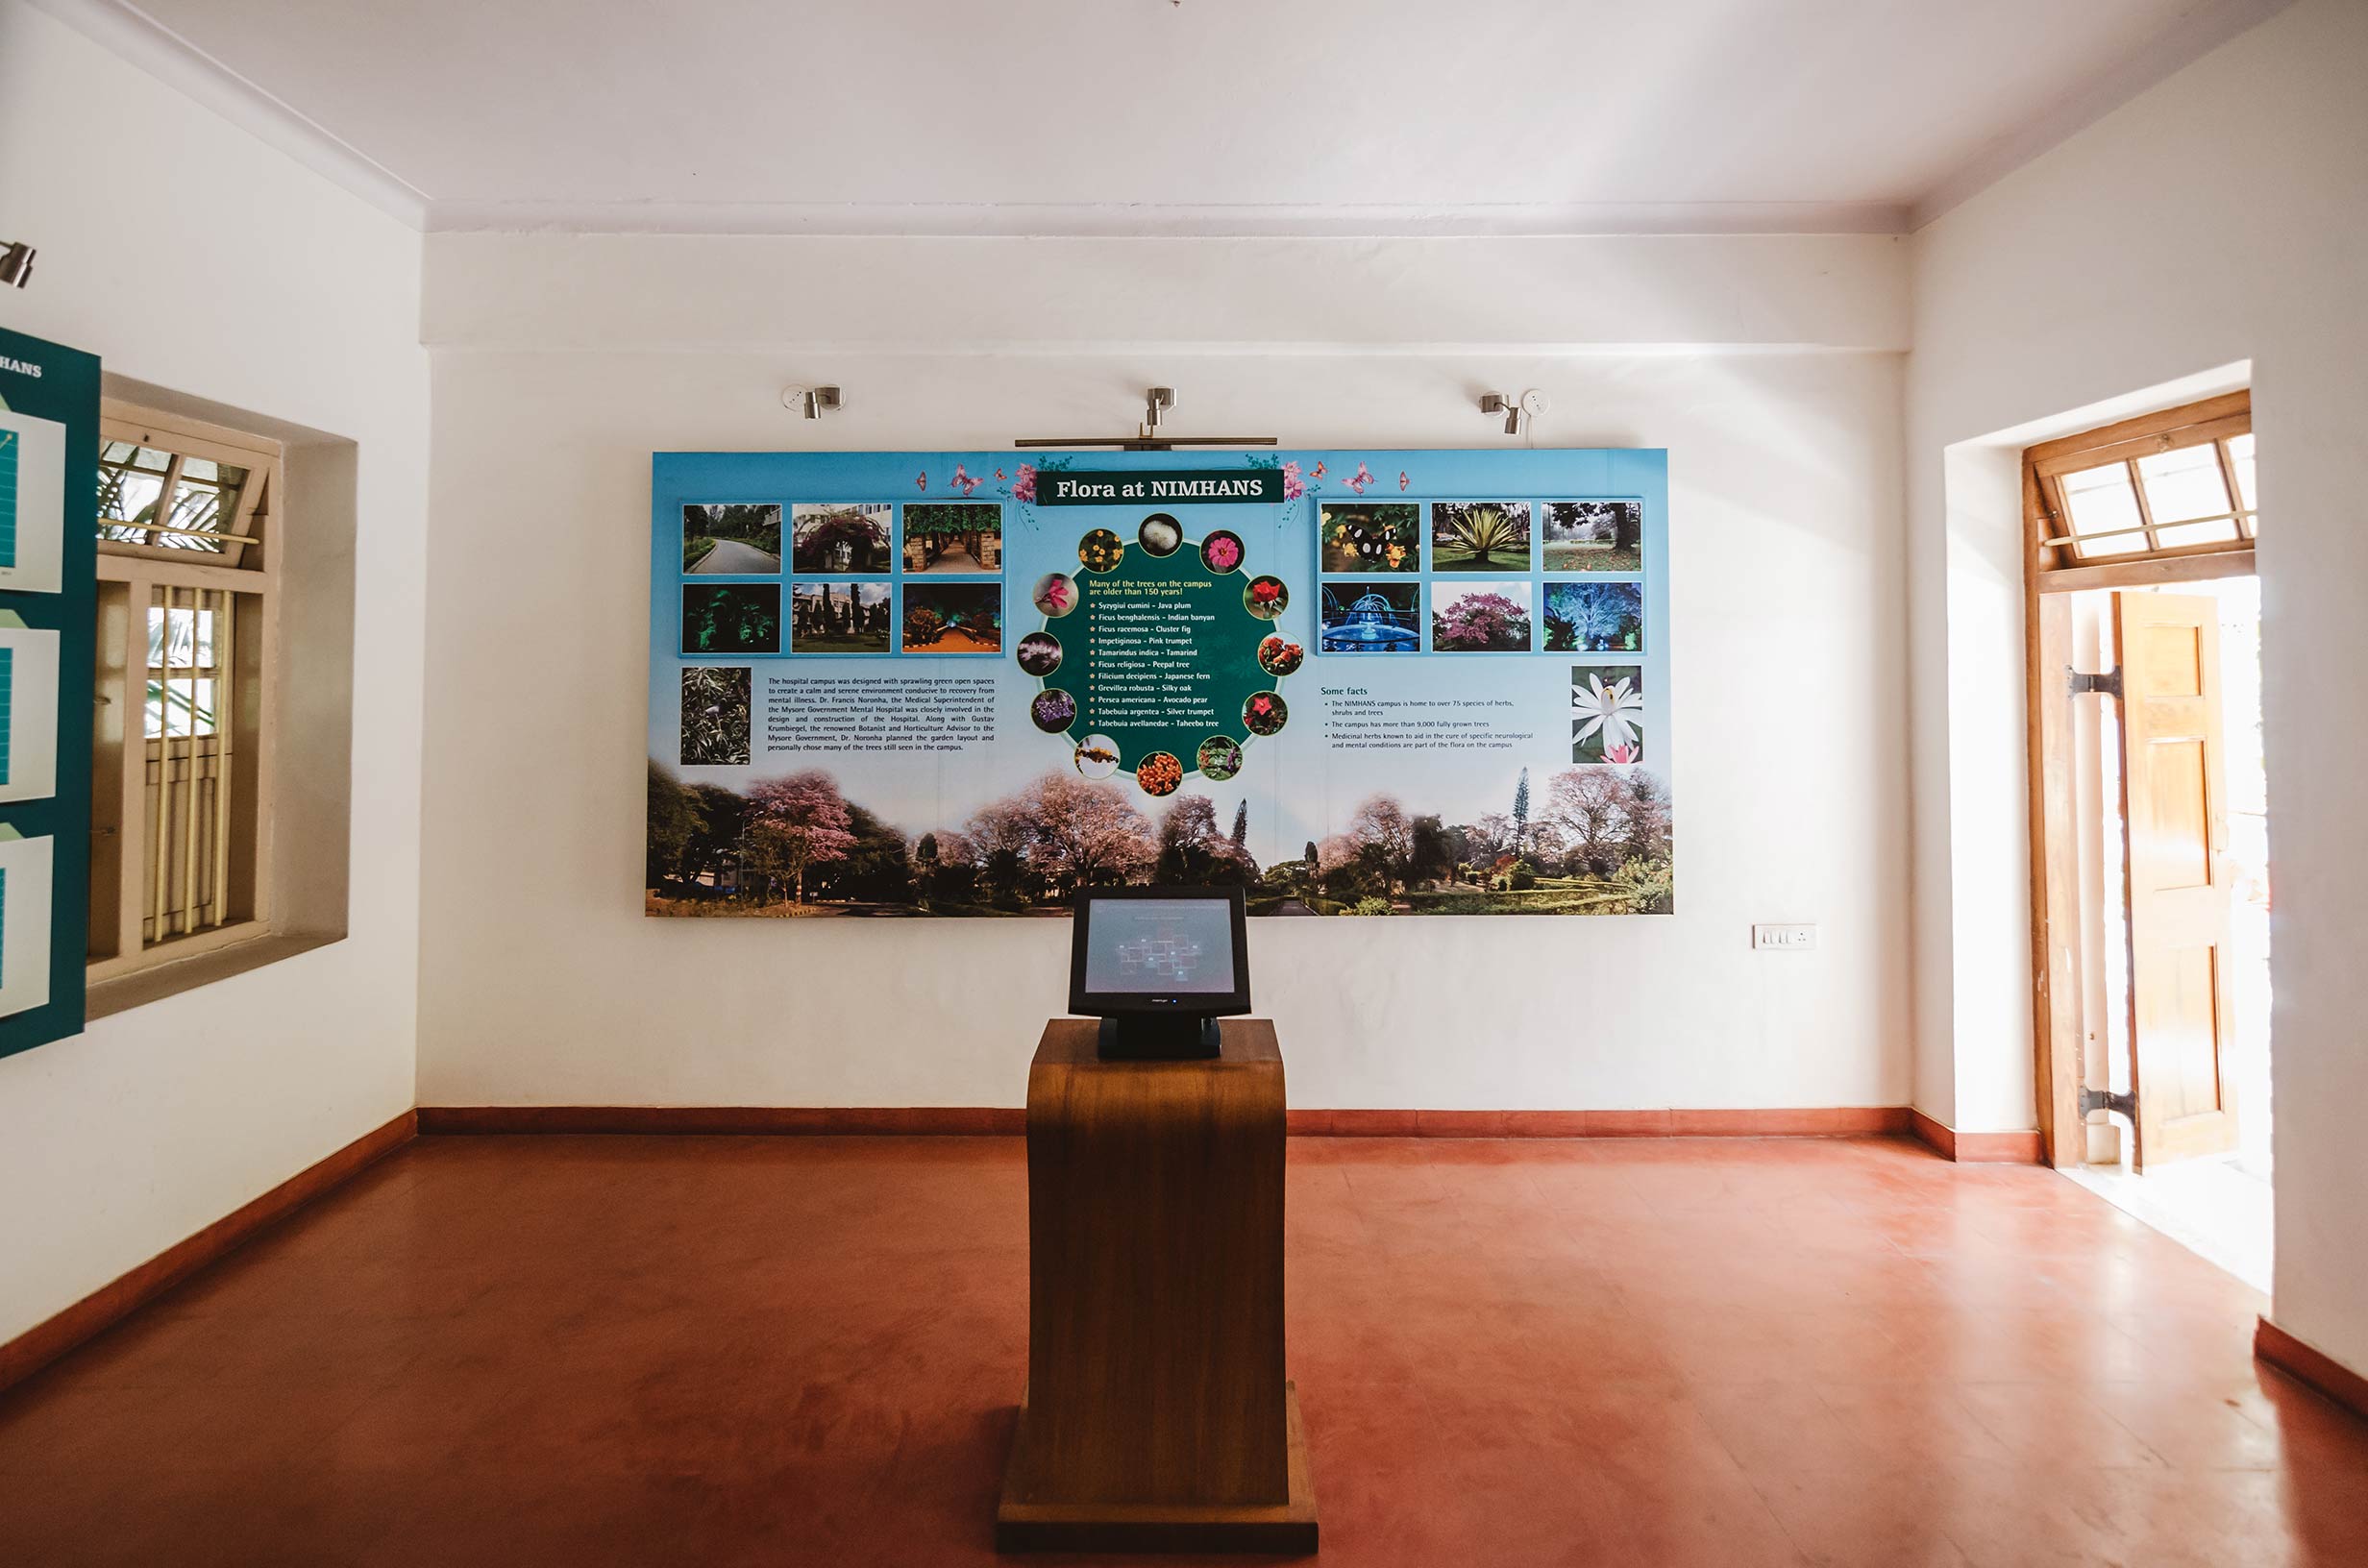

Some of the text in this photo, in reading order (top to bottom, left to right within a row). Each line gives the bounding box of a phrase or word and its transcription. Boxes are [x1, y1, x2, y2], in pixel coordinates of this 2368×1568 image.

[1057, 479, 1263, 498] Flora at NIMHANS
[1161, 588, 1183, 597] years!
[1181, 625, 1191, 634] fig
[1098, 637, 1142, 646] Impetiginosa
[1117, 661, 1146, 670] religiosa
[1125, 673, 1157, 681] decipiens
[1162, 684, 1178, 693] Silky
[1187, 708, 1214, 717] trumpet
[768, 734, 792, 743] Mysore
[930, 734, 953, 743] garden
